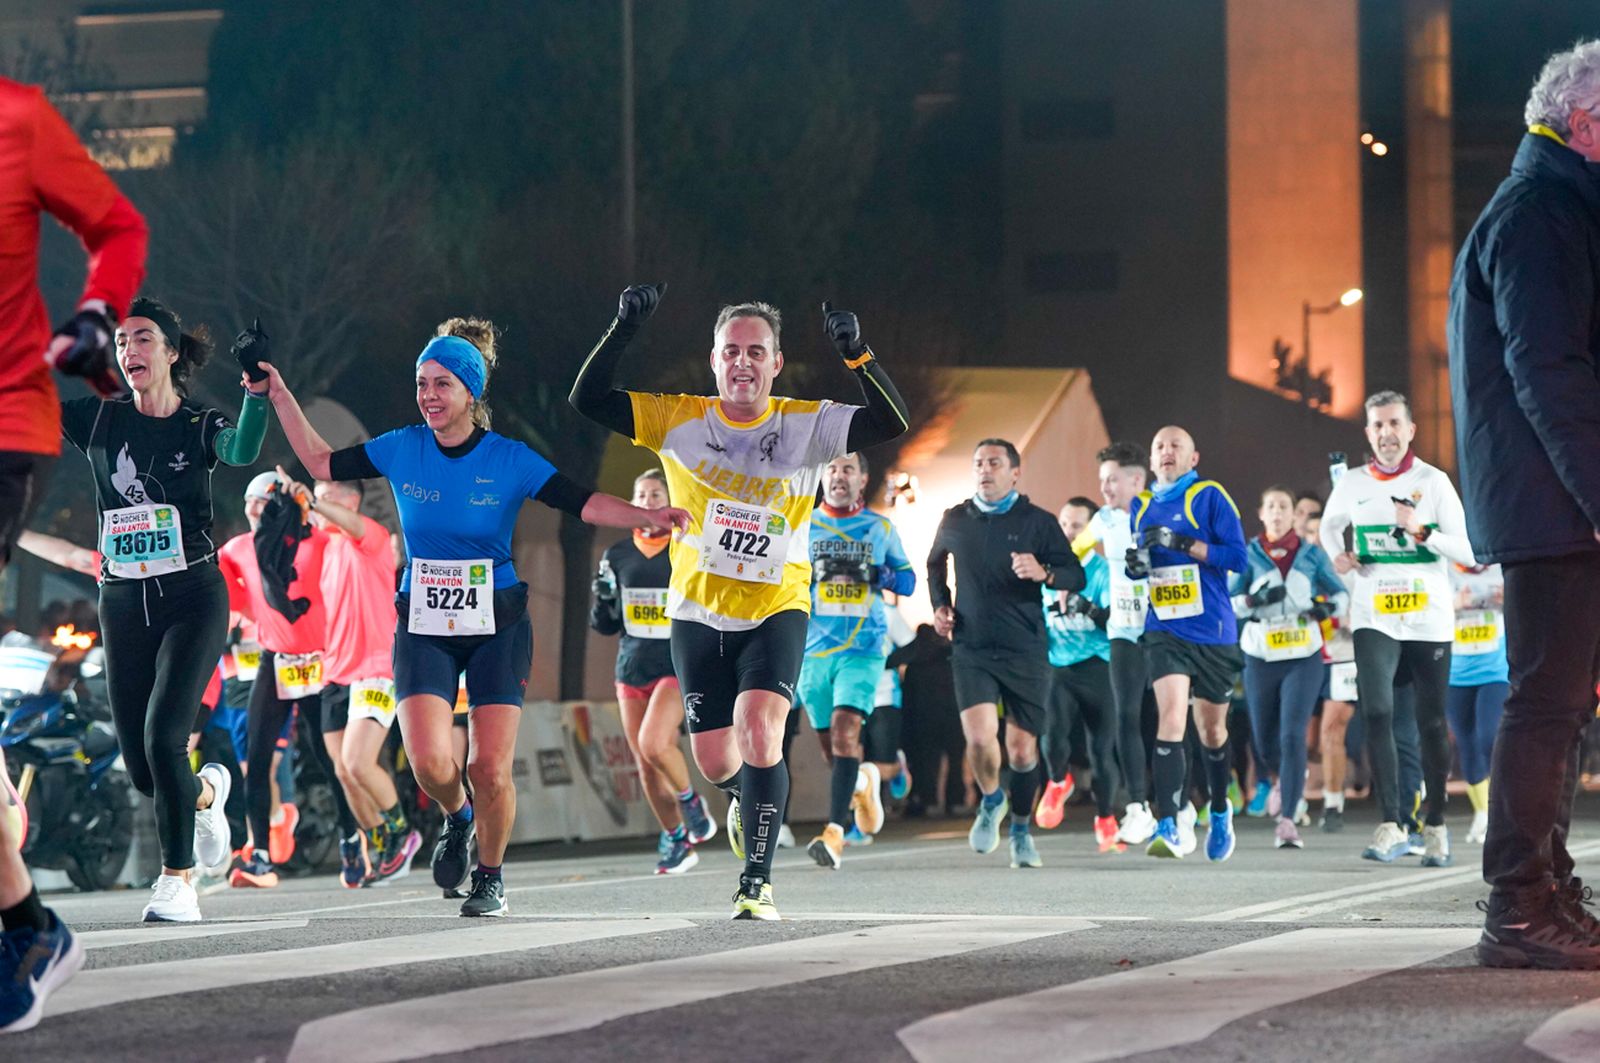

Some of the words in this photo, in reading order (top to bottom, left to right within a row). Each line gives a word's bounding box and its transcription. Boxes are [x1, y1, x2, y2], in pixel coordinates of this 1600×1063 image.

[125, 484, 144, 503] 43
[402, 481, 441, 504] olaya
[120, 514, 141, 524] NOCHE
[141, 513, 149, 521] DE
[714, 515, 731, 526] SAN
[751, 514, 761, 523] DE
[112, 525, 125, 535] SAN
[113, 530, 171, 556] 13675
[719, 529, 771, 557] 4722
[813, 540, 874, 553] DEPORTIVO
[430, 568, 451, 577] NOCHE
[452, 568, 462, 577] DE
[420, 576, 435, 585] SAN
[436, 577, 463, 587] ANTÓN
[426, 586, 478, 610] 5224
[1155, 584, 1190, 602] 8563
[1385, 593, 1418, 609] 3121
[750, 803, 777, 864] kalenji
